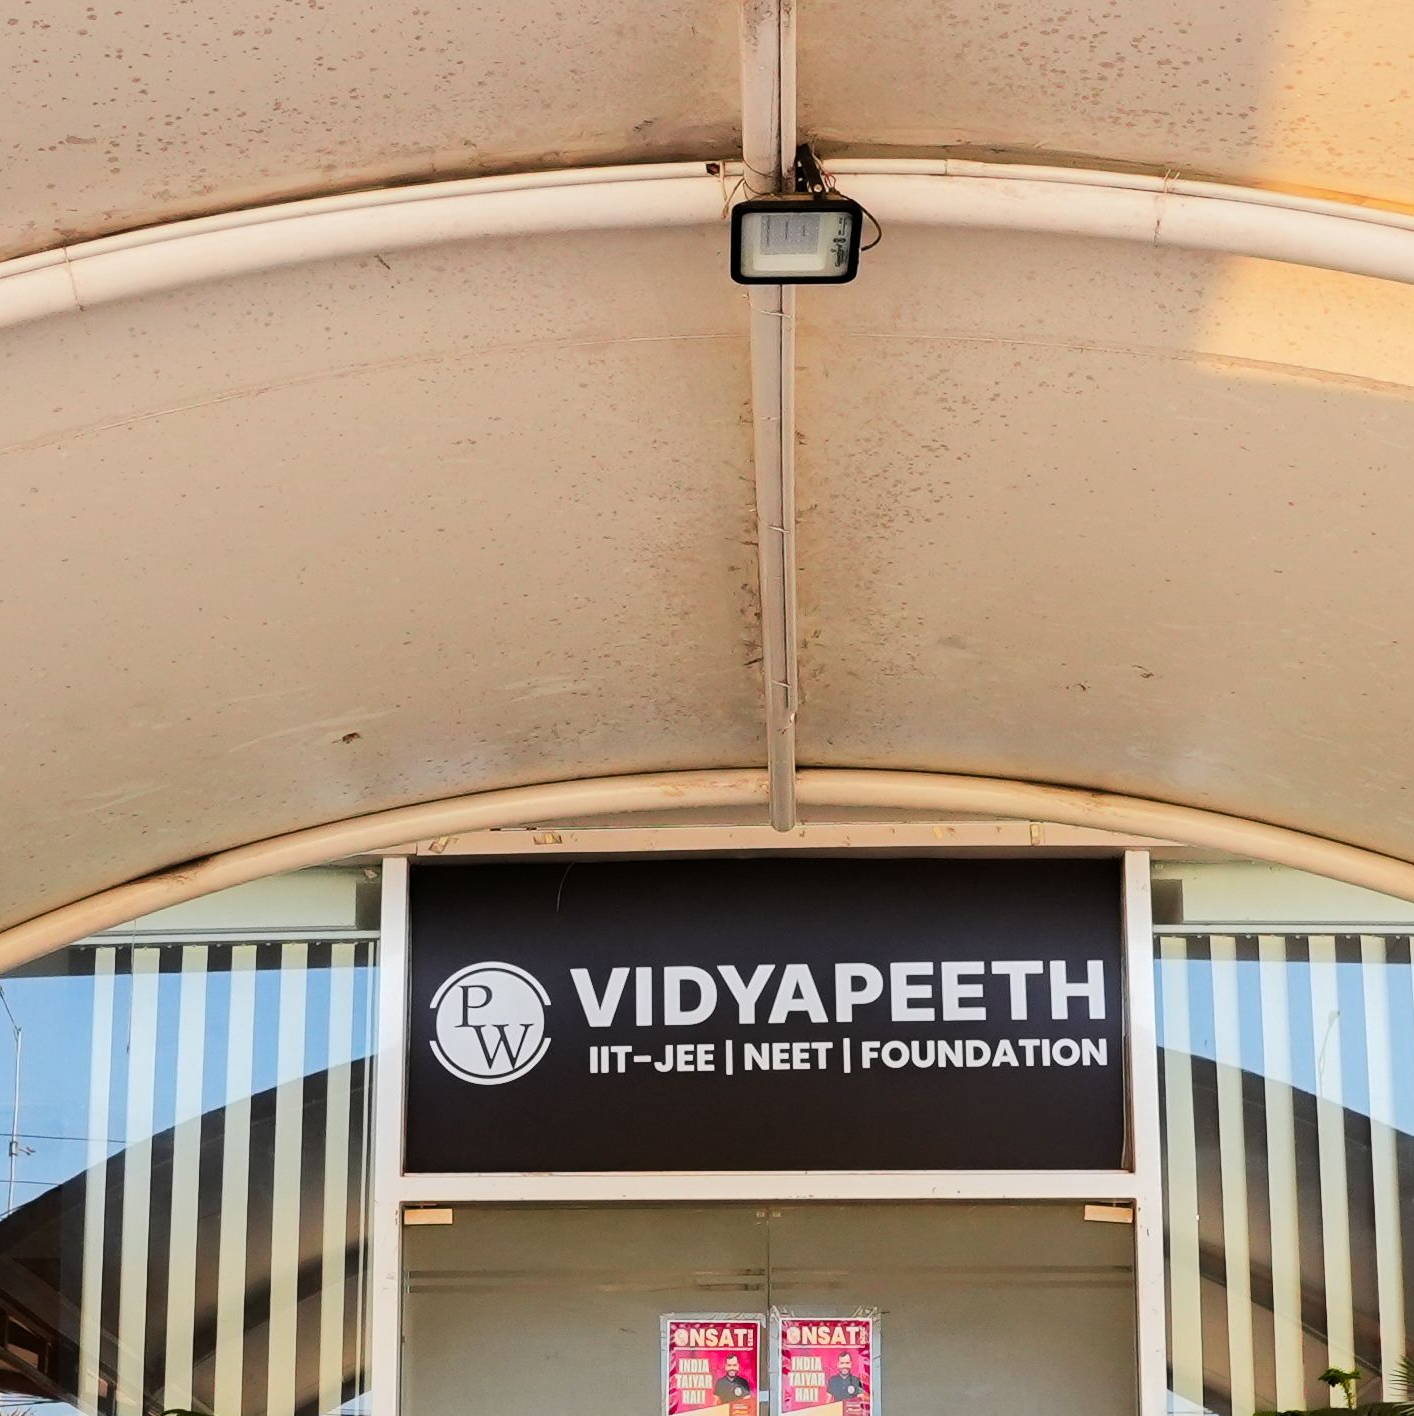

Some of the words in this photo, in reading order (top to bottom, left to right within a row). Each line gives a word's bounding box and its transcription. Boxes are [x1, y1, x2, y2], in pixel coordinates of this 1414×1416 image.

[569, 959, 1107, 1028] VIDYAPEETH
[589, 1044, 715, 1074] IIT-JEE
[743, 1042, 833, 1072] NEET
[861, 1037, 1108, 1070] FOUNDATION
[679, 1359, 710, 1373] INDIA
[675, 1374, 713, 1388] TAIYAR
[788, 1372, 825, 1386] TAIYAR
